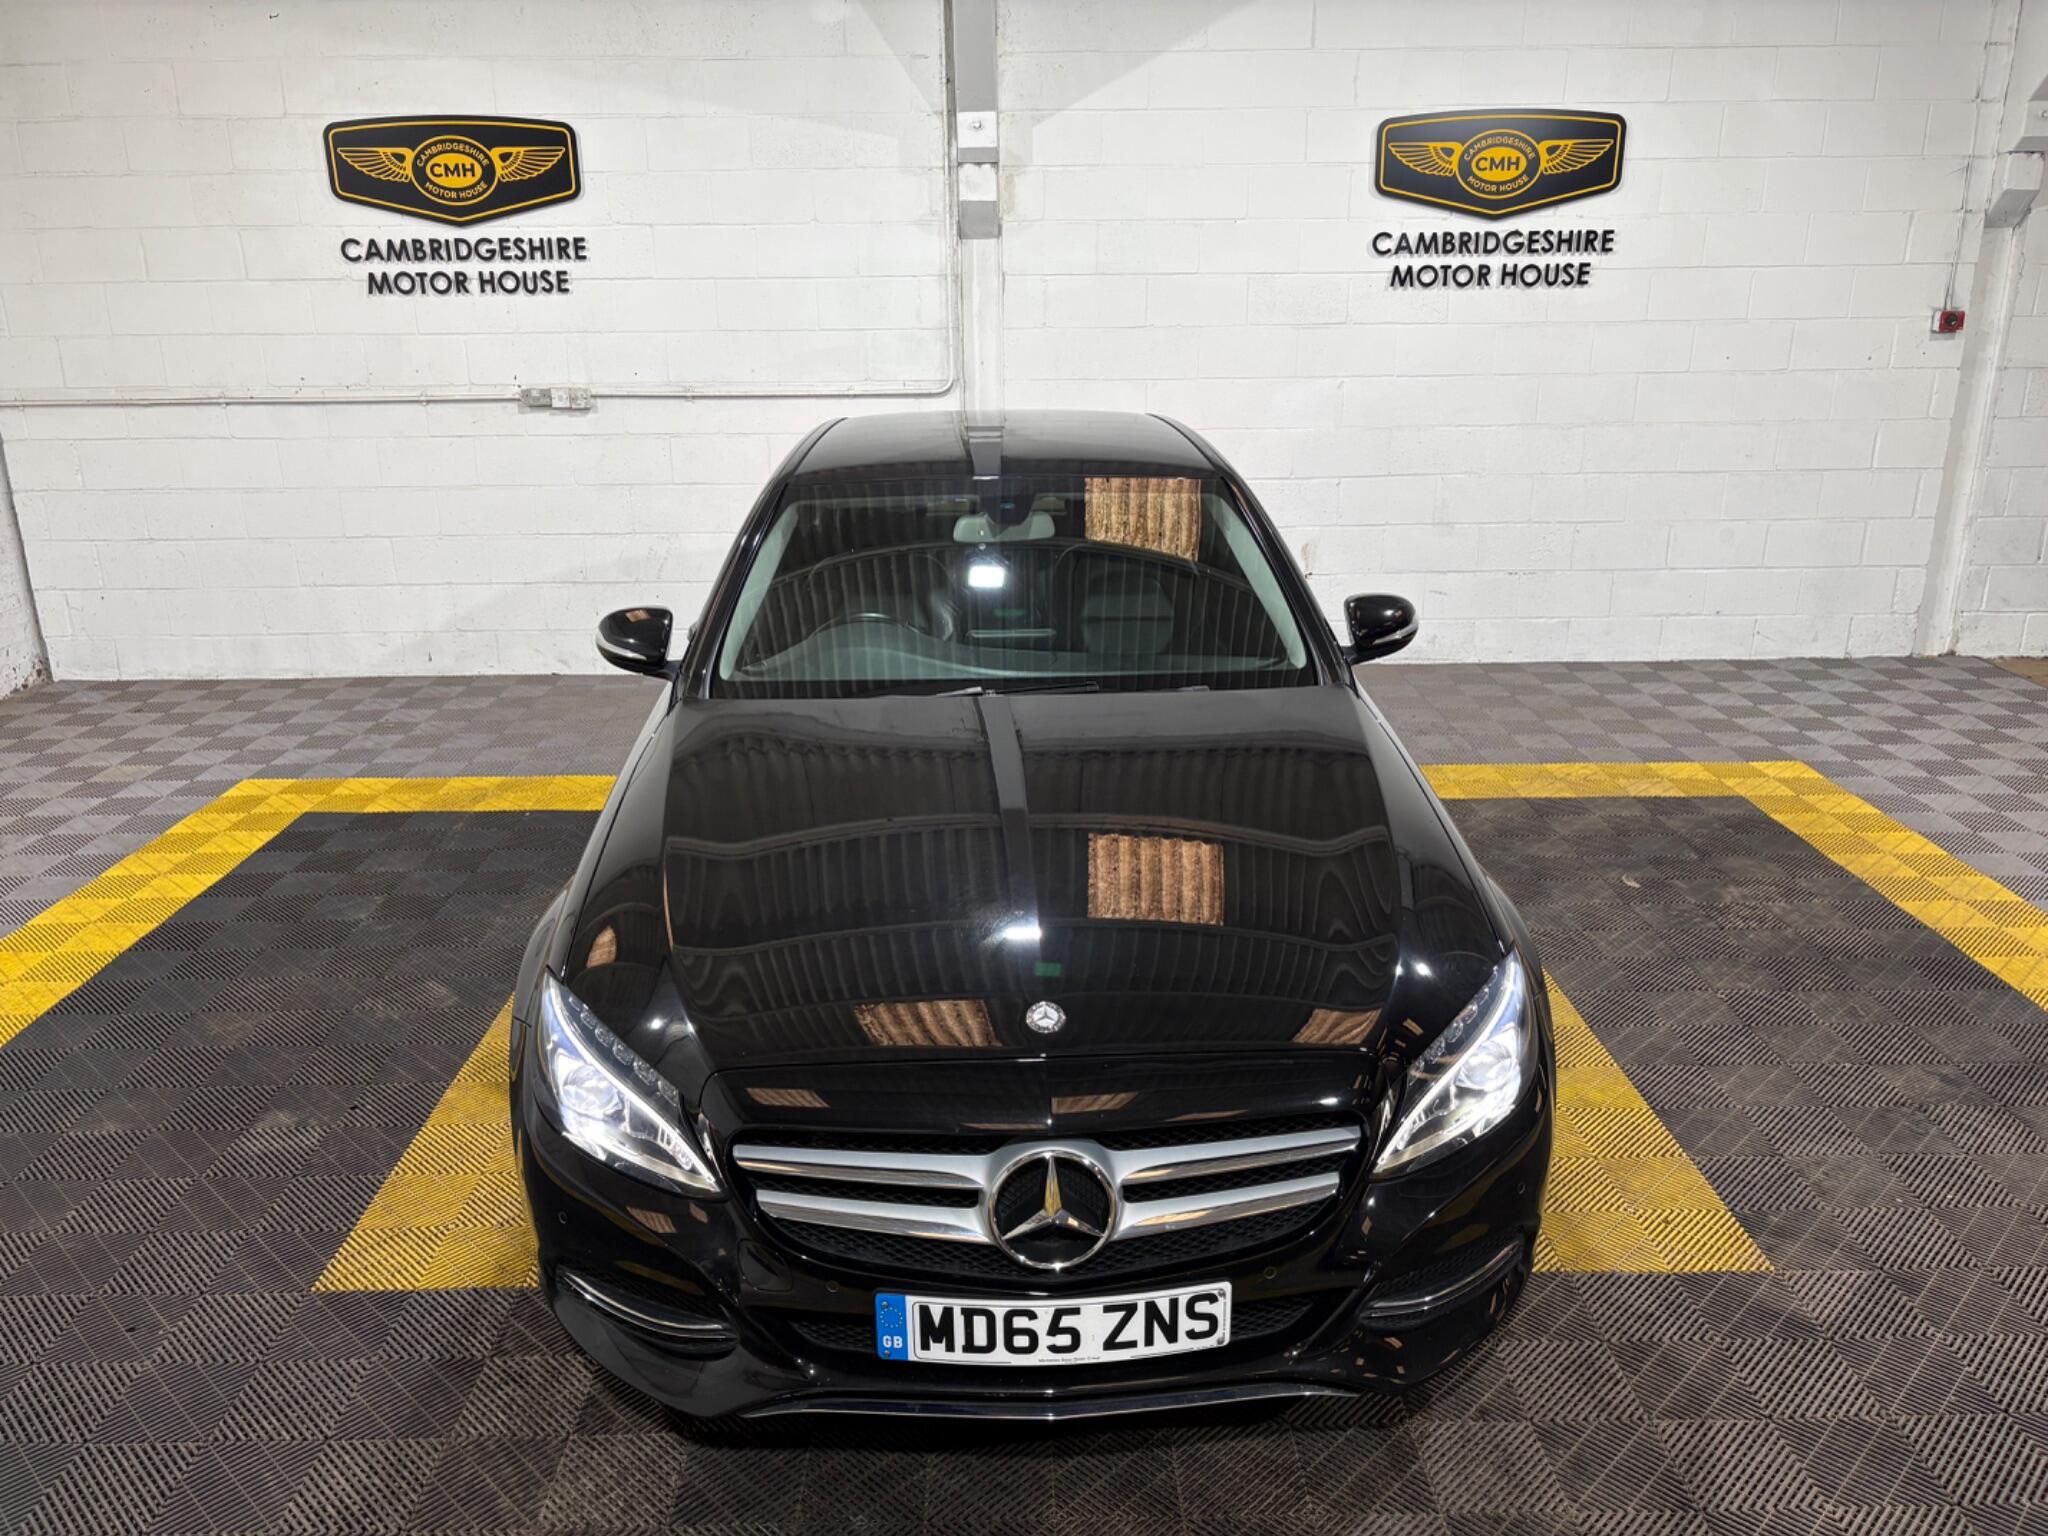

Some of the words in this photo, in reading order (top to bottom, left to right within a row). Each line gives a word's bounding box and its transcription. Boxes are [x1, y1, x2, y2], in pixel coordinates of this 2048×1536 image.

[416, 142, 490, 167] CAMBRIDGESHIRE
[1463, 136, 1536, 161] CAMBRIDGESHIRE
[429, 162, 476, 178] CMH
[1475, 155, 1521, 171] CMH
[425, 181, 458, 199] MOTOR
[459, 180, 488, 199] HOUSE
[1467, 175, 1498, 192] MOTOR
[1499, 174, 1530, 192] HOUSE
[341, 237, 588, 263] CAMBRIDGESHIRE
[1372, 229, 1616, 256] CAMBRIDGESHIRE
[368, 270, 471, 295] MOTOR
[479, 269, 571, 294] HOUSE
[1390, 264, 1492, 288] MOTOR
[1500, 262, 1592, 286] HOUSE
[918, 1304, 1082, 1355] MD65
[1102, 1292, 1220, 1351] ZNS
[882, 1335, 903, 1349] GB
